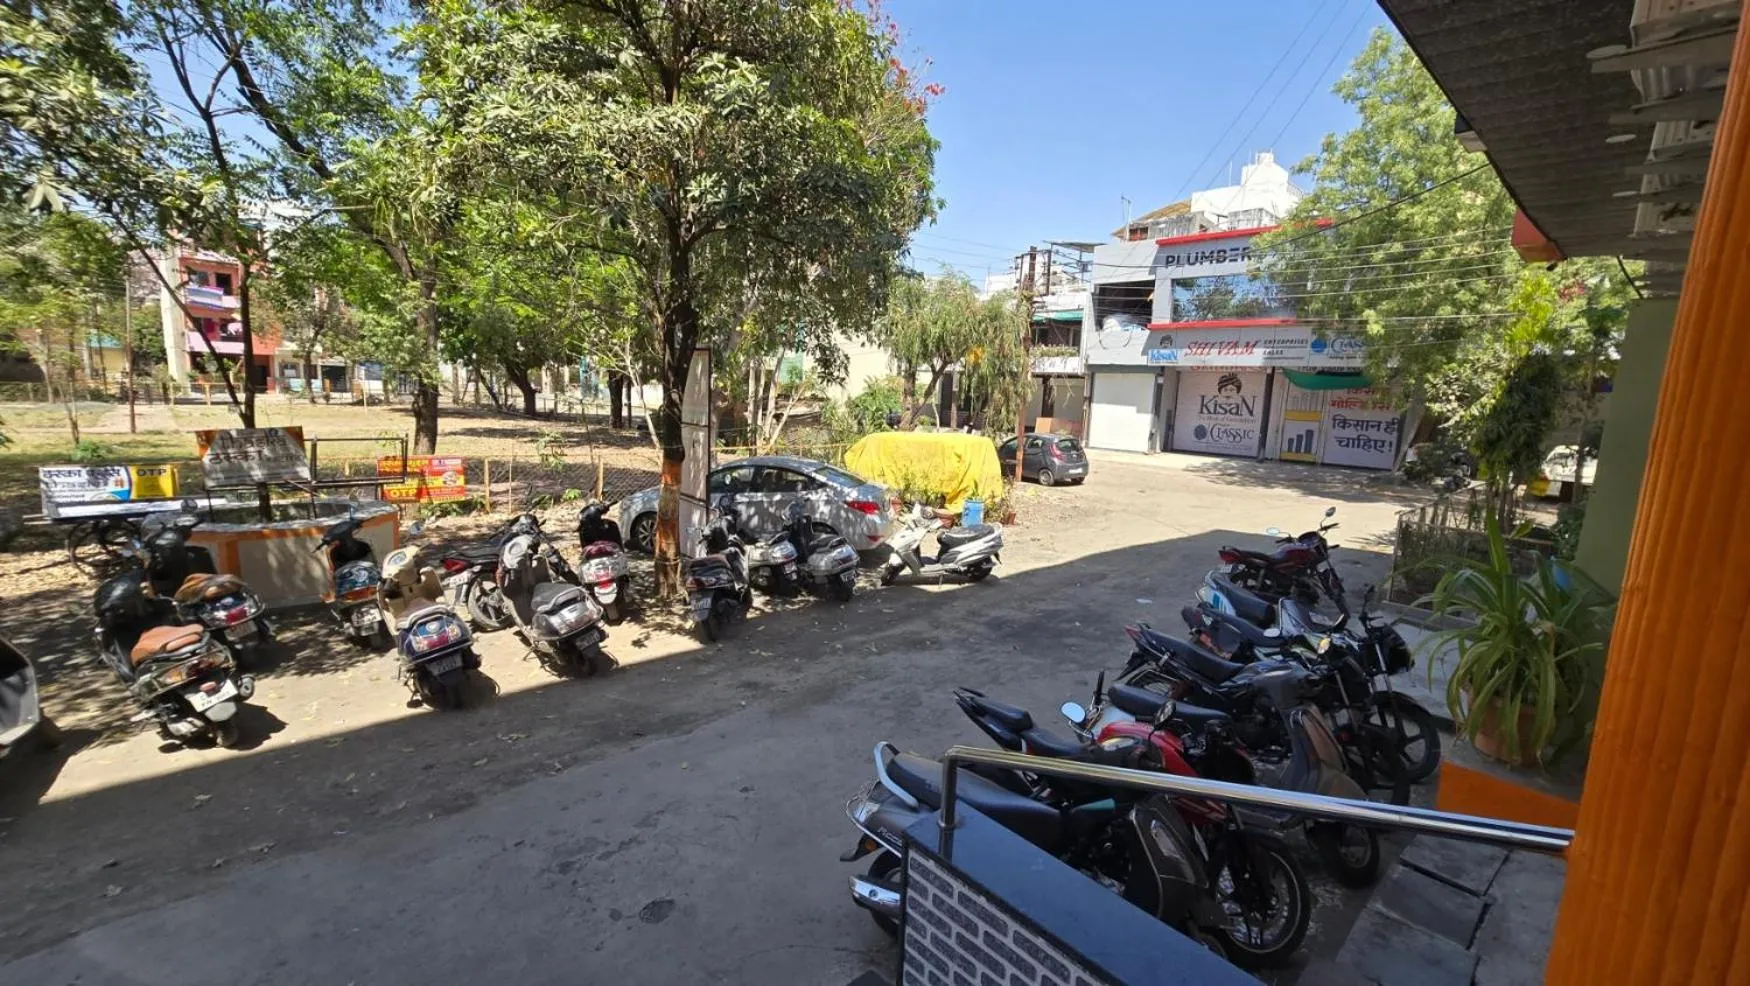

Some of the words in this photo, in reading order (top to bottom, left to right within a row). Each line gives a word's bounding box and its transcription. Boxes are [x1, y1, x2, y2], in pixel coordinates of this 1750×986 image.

[1184, 339, 1261, 356] SHIVAM
[1332, 414, 1381, 432] किसान
[1383, 416, 1400, 435] ही
[1335, 434, 1393, 454] चाहिए!
[390, 488, 418, 499] OTP
